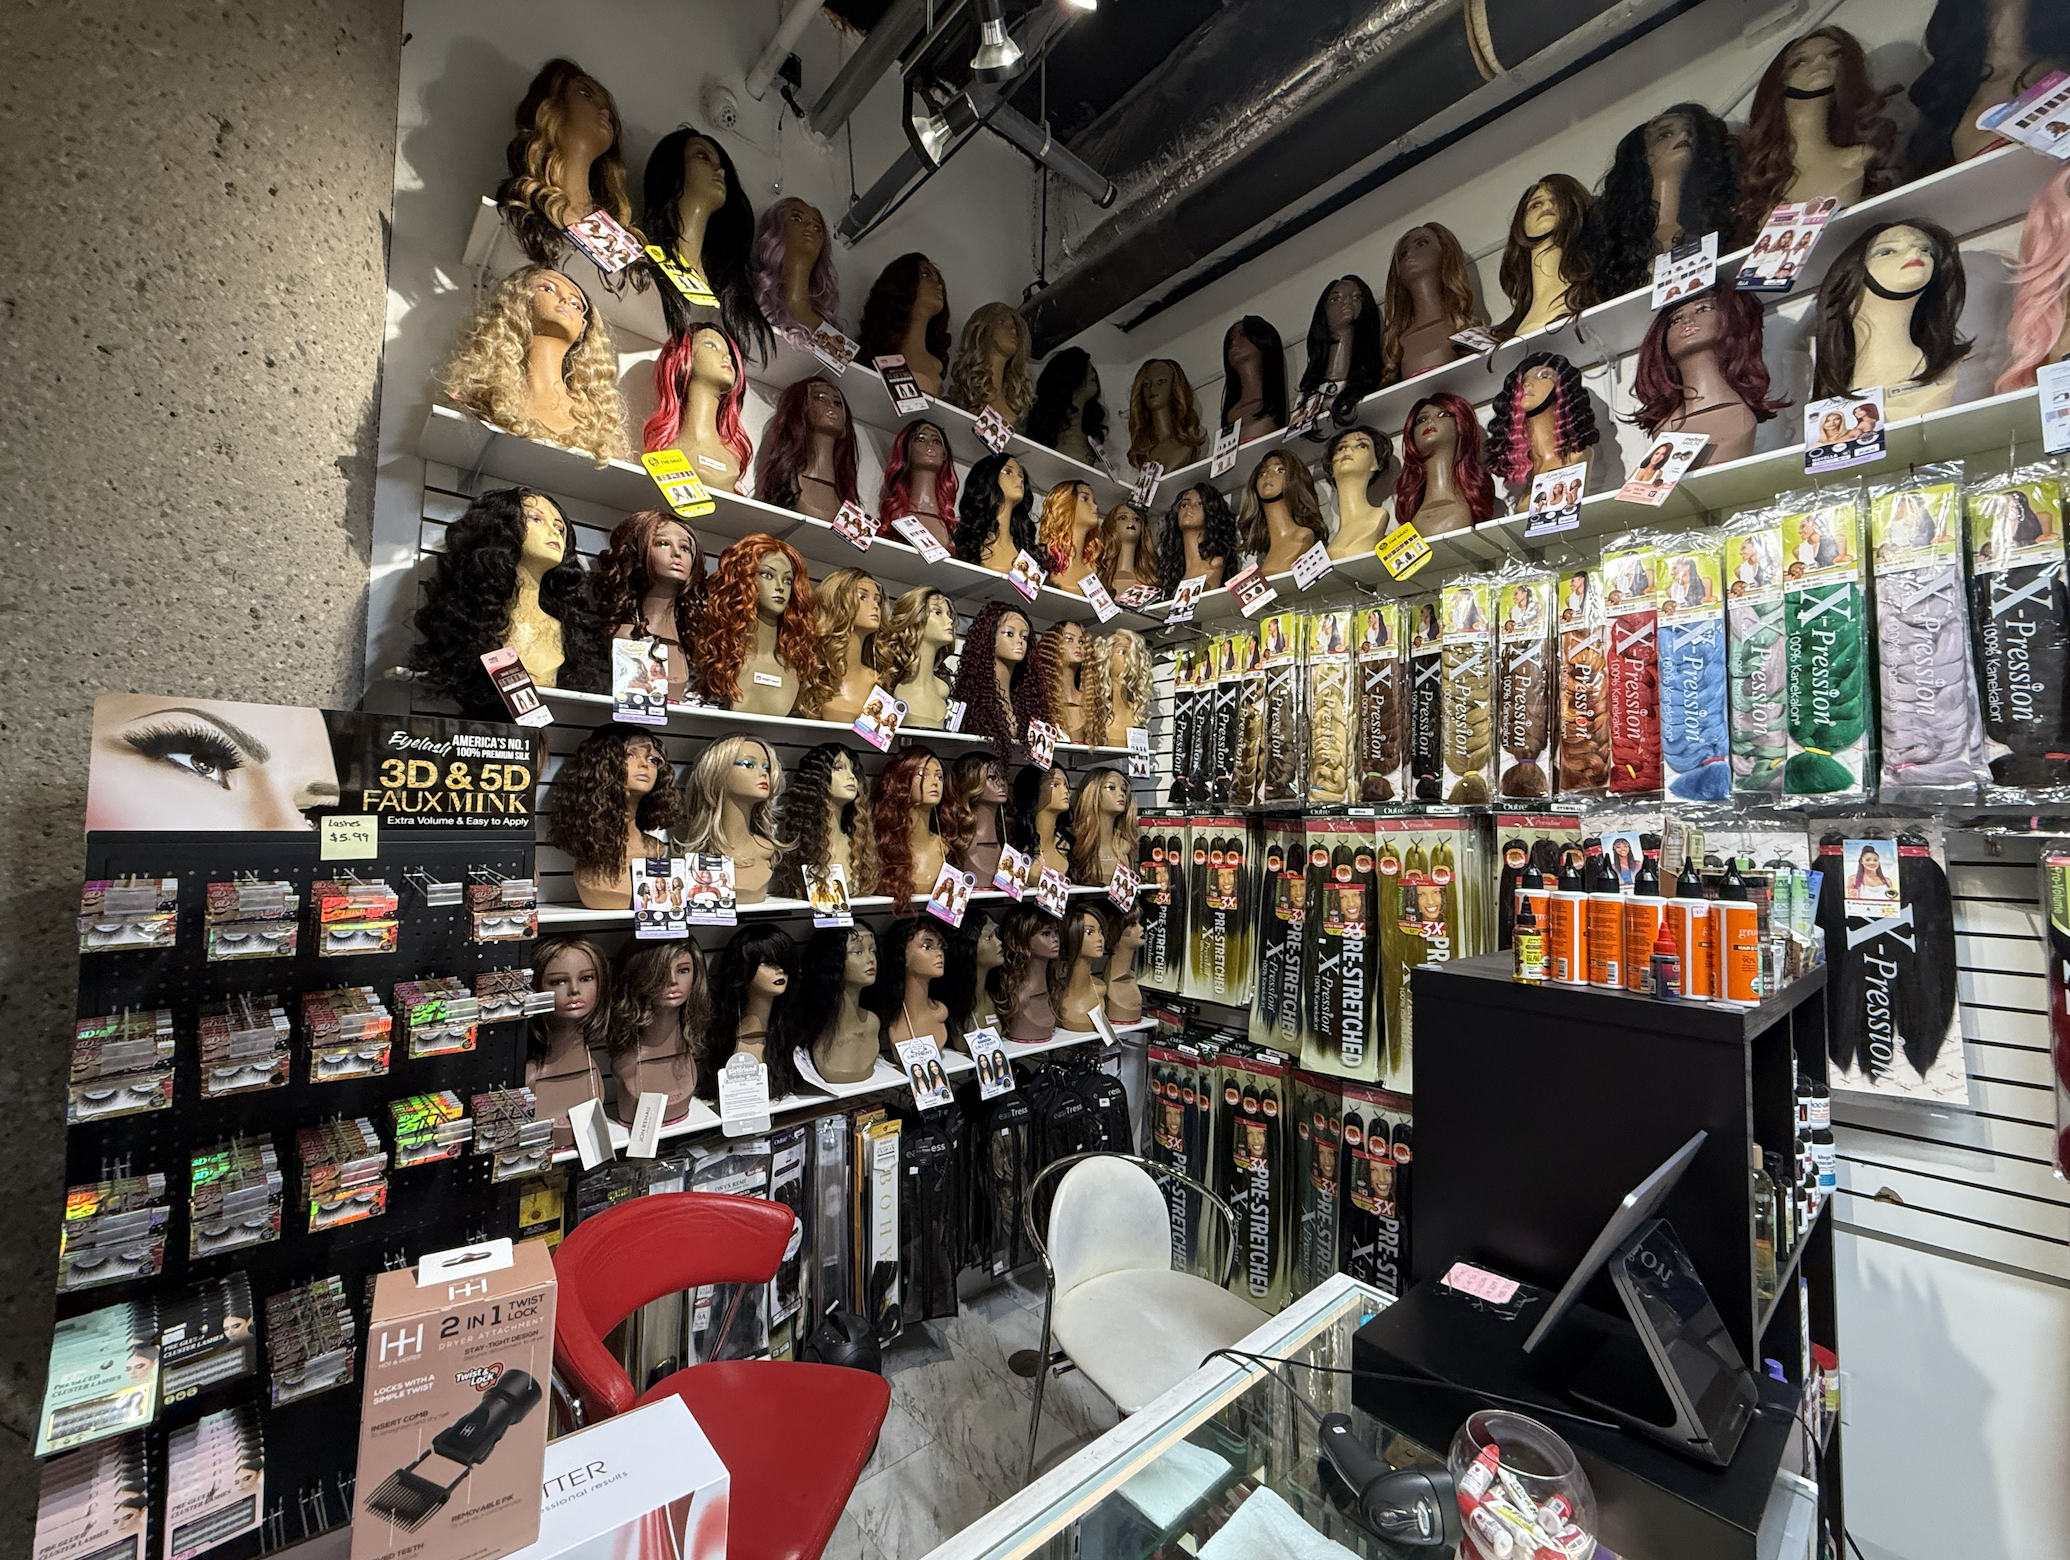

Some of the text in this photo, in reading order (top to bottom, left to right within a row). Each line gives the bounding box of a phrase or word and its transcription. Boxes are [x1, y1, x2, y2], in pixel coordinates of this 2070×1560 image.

[1801, 583, 1852, 728] X-Pression
[1901, 569, 1956, 717] X-Pression
[1990, 574, 2054, 723] X-Pression
[1614, 618, 1656, 741] X-Pression
[1672, 618, 1716, 743] X-Pression
[1740, 609, 1786, 737] X-Pression
[1790, 630, 1802, 726] 100% Kanekalon
[1983, 623, 2003, 723] 100% Kanekalon
[1415, 659, 1442, 759] X-Pression
[1449, 653, 1485, 758] X-Pression
[1509, 643, 1543, 750] X-Pression
[1611, 658, 1621, 740] 100% Kanekalon
[1365, 663, 1393, 761] X-Pression
[1501, 675, 1512, 747] 100% Kanekalon
[388, 730, 452, 757] Eyelash
[452, 734, 506, 750] AMERICA'S
[456, 746, 530, 761] 100% PREMIUM SILK
[379, 758, 531, 792] 3D & 5D
[362, 789, 529, 814] FAUX MINK
[1503, 802, 1528, 811] Outre
[328, 818, 362, 828] Lashes
[387, 816, 530, 828] Extra Volume & Easy to Apply
[329, 831, 370, 843] $5.99
[1218, 896, 1237, 911] 3X
[2051, 867, 2064, 915] Pro-Volume
[1288, 908, 1306, 923] 3X
[1418, 920, 1444, 938] 3X
[1154, 905, 1168, 984] PRE-STRETCHED
[1213, 911, 1226, 995] PRE-STRETCHED
[1266, 938, 1285, 1013] X-Pression
[1281, 920, 1304, 1042] PRE-STRETCHED
[1318, 950, 1340, 1036] X-Pression
[1341, 929, 1364, 1068] PRE-STRETCHED
[1845, 902, 1917, 1079] X-Pression
[998, 1106, 1029, 1121] easiTress
[1053, 1102, 1084, 1120] easiTress
[639, 1106, 651, 1143] JON RENAU
[1165, 1134, 1182, 1150] 3X
[715, 1178, 748, 1192] ONYX REMI
[1317, 1178, 1338, 1195] 3X
[1369, 1197, 1395, 1216] 3X
[1250, 1168, 1270, 1298] PRE-STRETCHED
[507, 1306, 538, 1321] LOCK
[508, 1293, 546, 1310] TWIST
[438, 1316, 545, 1351] DRYER ATTACHMENT
[440, 1304, 502, 1339] 2 IN 1
[162, 1333, 225, 1360] CLUSTER LASHES
[464, 1329, 539, 1355] STAY-TIGHT DESIGN
[51, 1374, 122, 1399] CLUSTER LASHES
[373, 1373, 436, 1397] LOCKS WITH A
[456, 1367, 489, 1384] Twist &
[372, 1382, 435, 1406] SIMPLE TWIST
[371, 1417, 402, 1433] INSERT
[403, 1410, 429, 1423] COMB
[590, 1470, 629, 1492] results
[170, 1505, 204, 1520] CLUSTER
[451, 1498, 501, 1523] REMOVABLE
[39, 1543, 57, 1554] PRE
[77, 1528, 110, 1547] LASHES
[397, 1542, 424, 1557] TEETH
